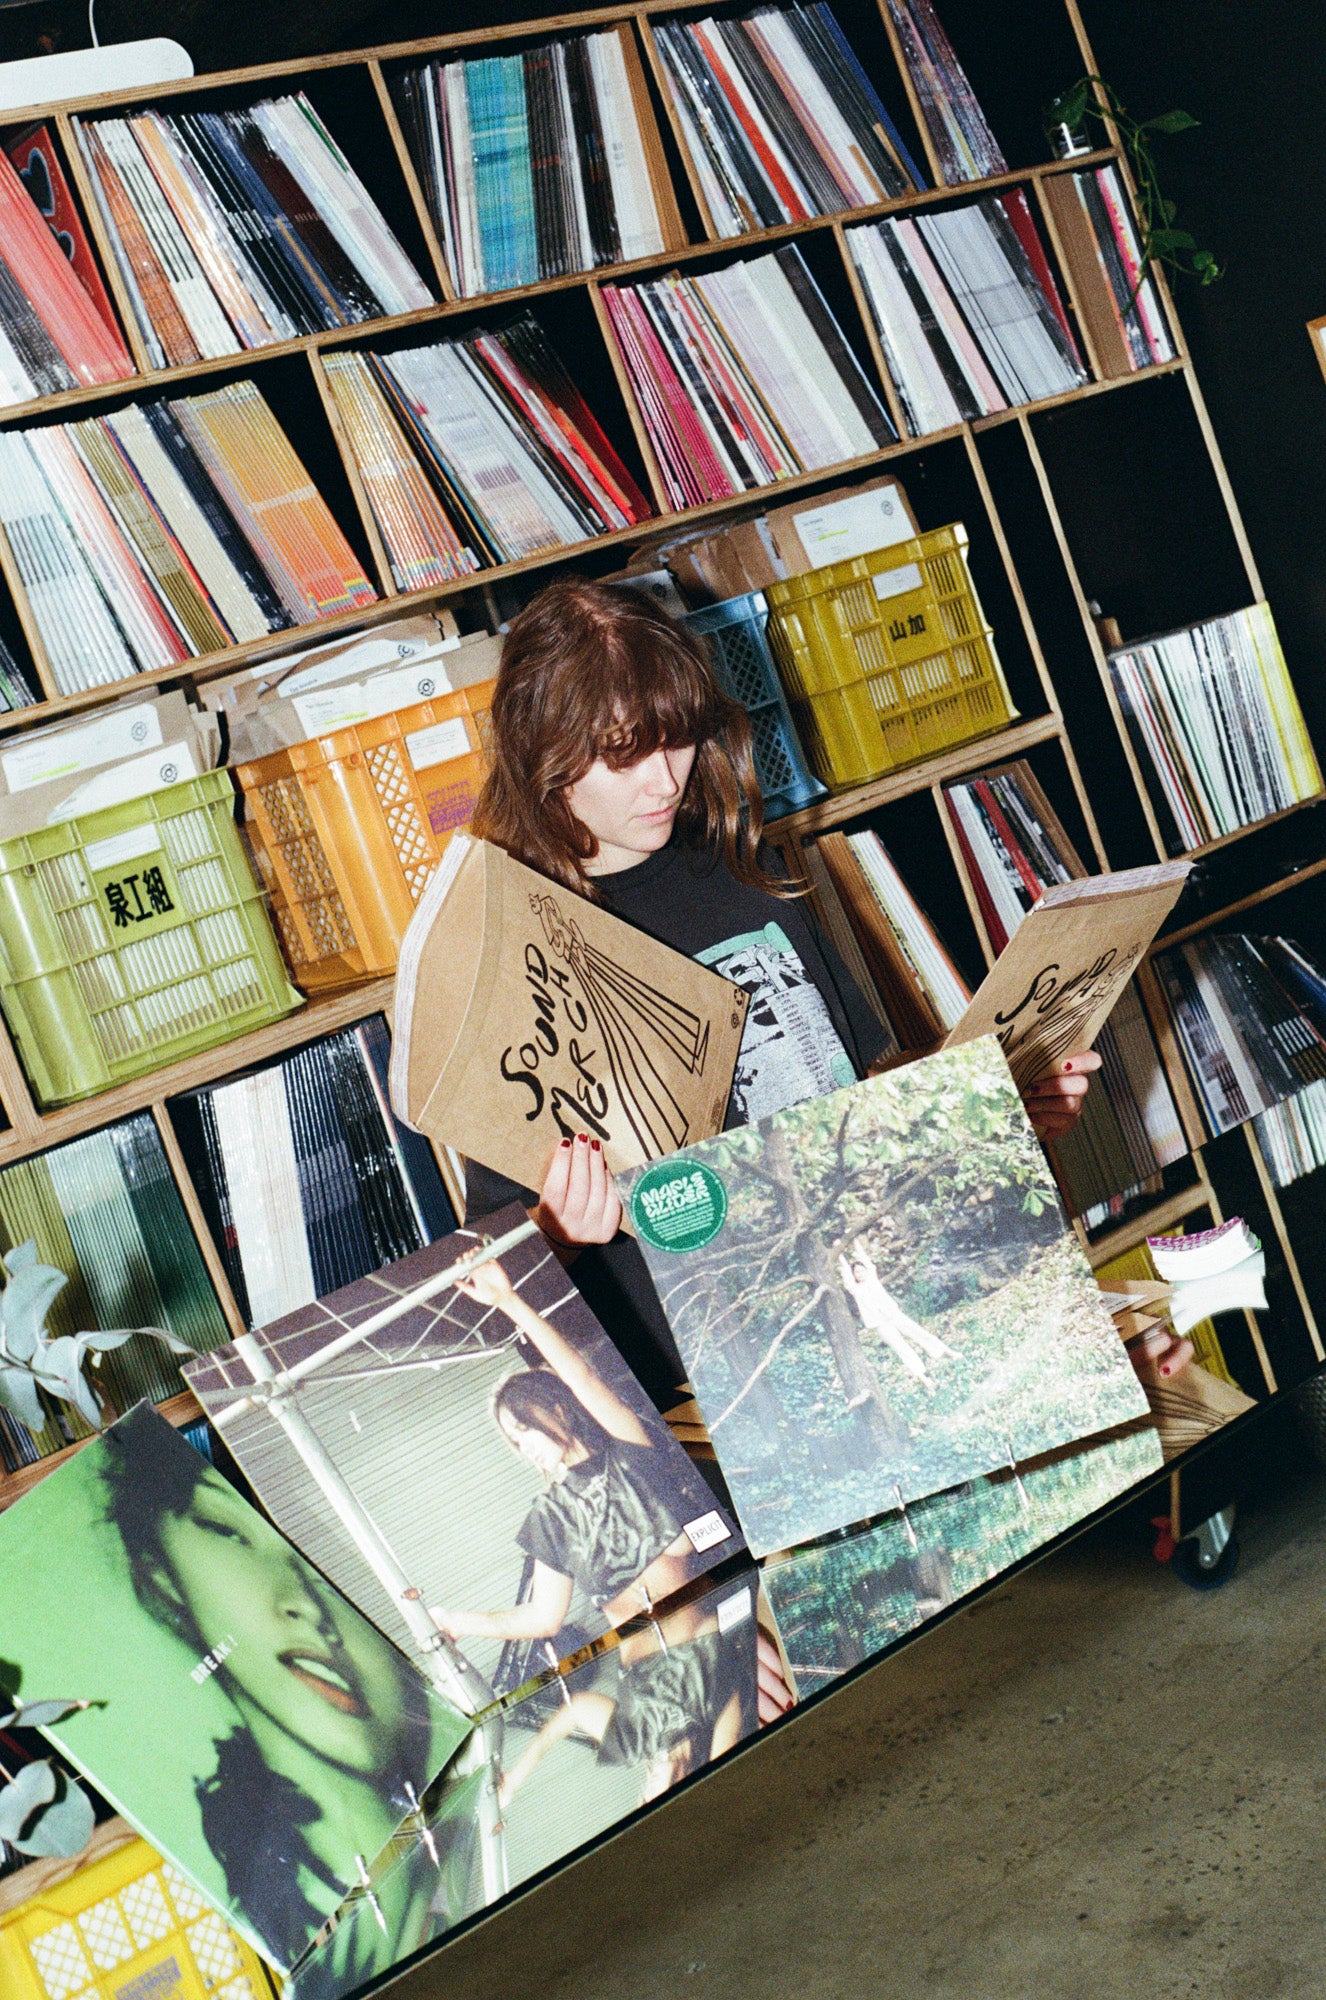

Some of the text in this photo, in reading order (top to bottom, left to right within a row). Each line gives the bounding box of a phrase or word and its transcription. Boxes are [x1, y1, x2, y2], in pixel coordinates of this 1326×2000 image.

[994, 948, 1118, 1026] SOUND
[500, 943, 560, 1122] SOUND
[550, 965, 612, 1142] MERCH
[640, 1171, 706, 1208] MAPLE
[645, 1183, 711, 1219] GLIDER
[690, 1518, 723, 1543] EXPLICIT
